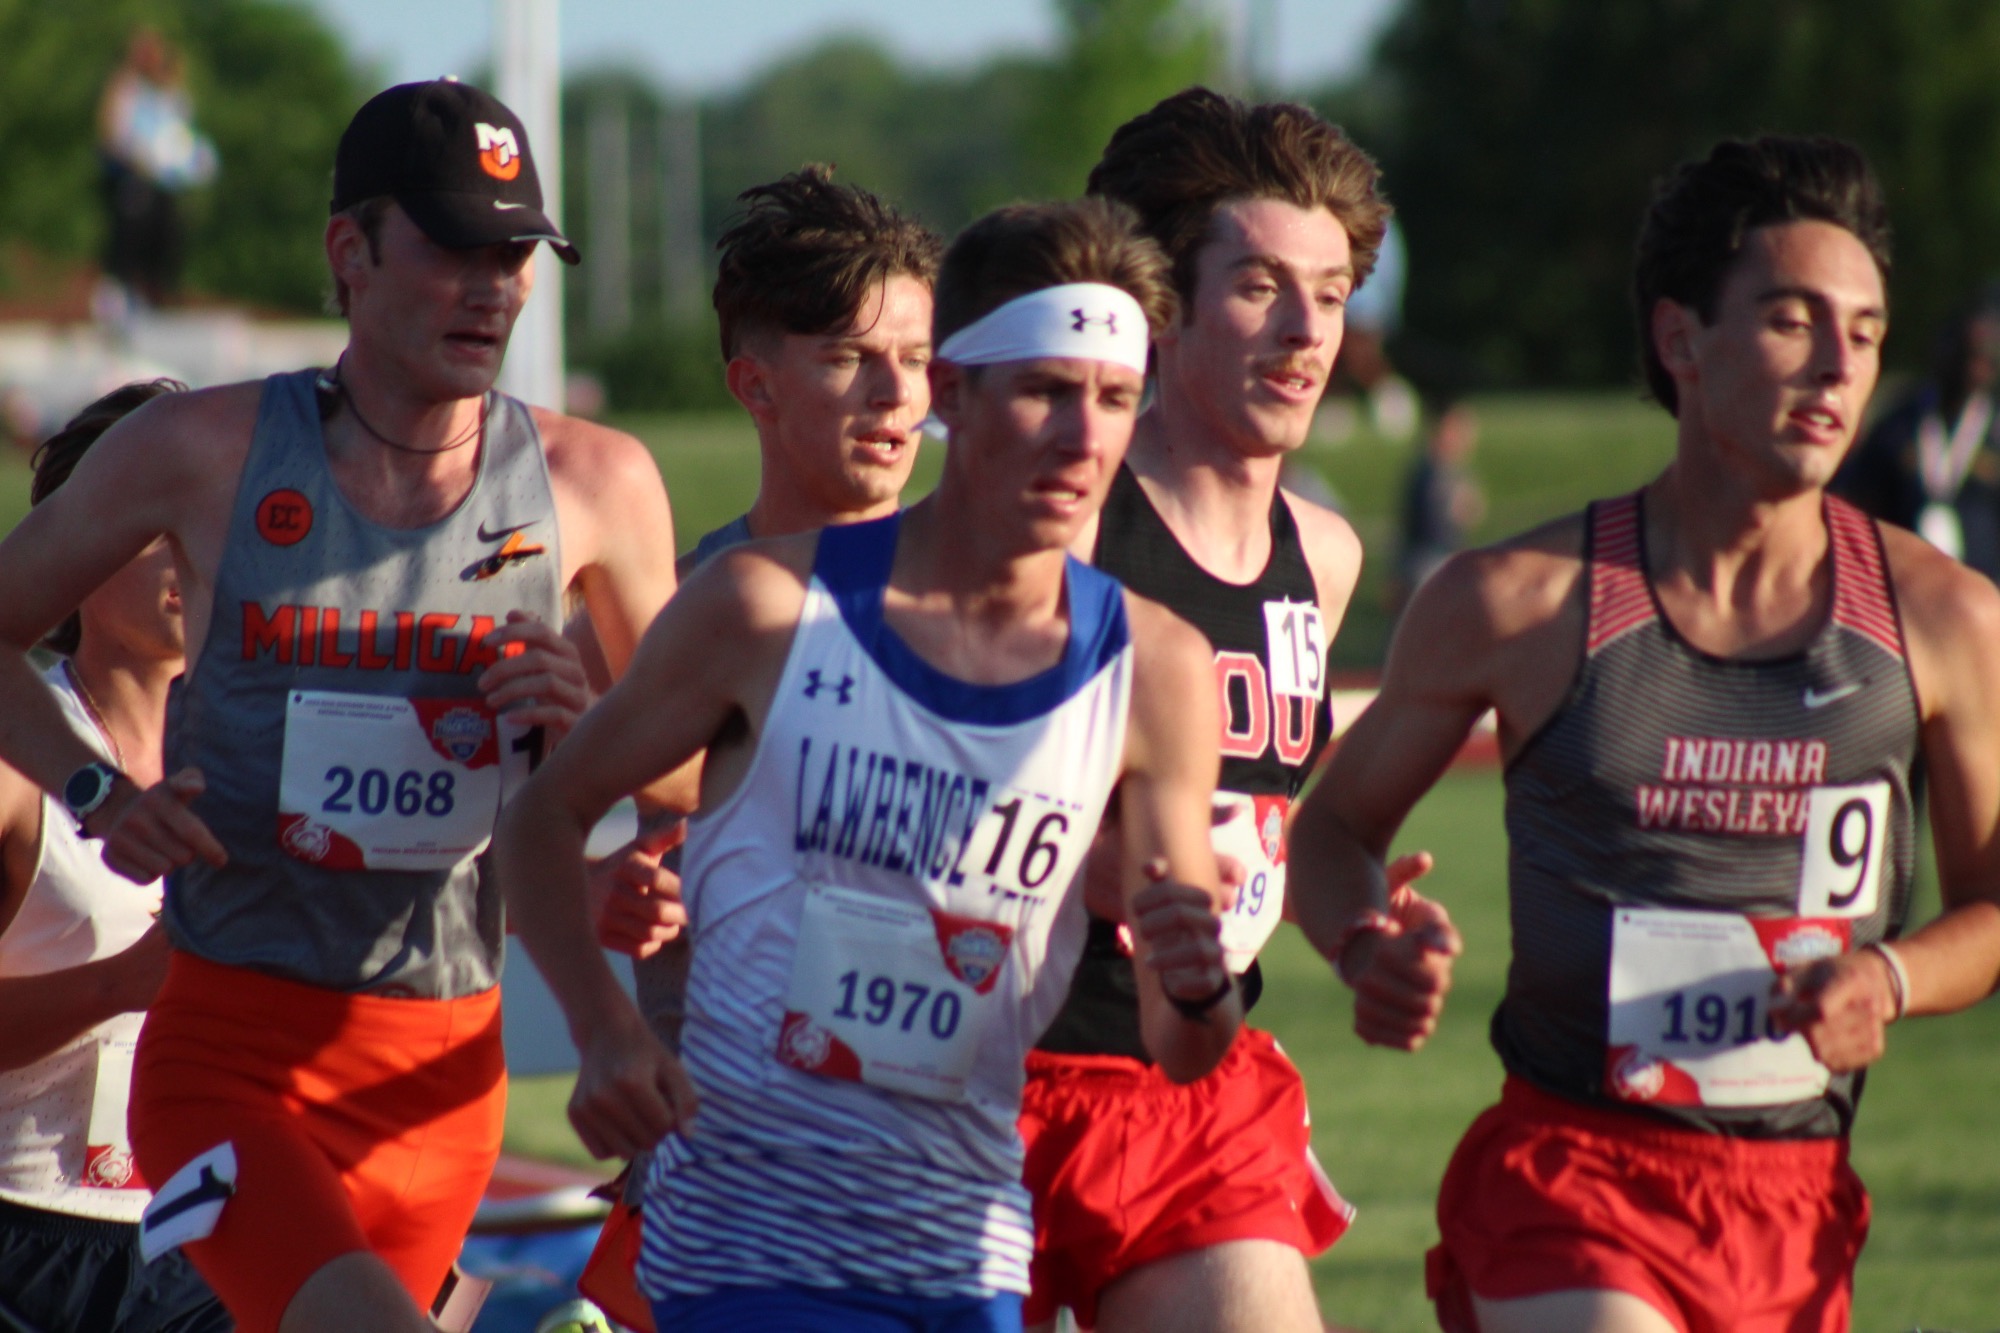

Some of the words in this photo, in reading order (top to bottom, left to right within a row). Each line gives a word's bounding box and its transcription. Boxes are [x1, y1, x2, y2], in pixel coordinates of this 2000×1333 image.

[268, 503, 302, 530] EC
[241, 600, 526, 674] MILLIGA
[1281, 611, 1321, 691] 15
[321, 766, 456, 818] 2068
[1661, 736, 1829, 784] INDIANA
[794, 736, 990, 887] LAWRENCE
[984, 798, 1069, 889] 16
[1826, 798, 1874, 909] 9
[832, 969, 962, 1041] 1970
[144, 1163, 233, 1234] 1
